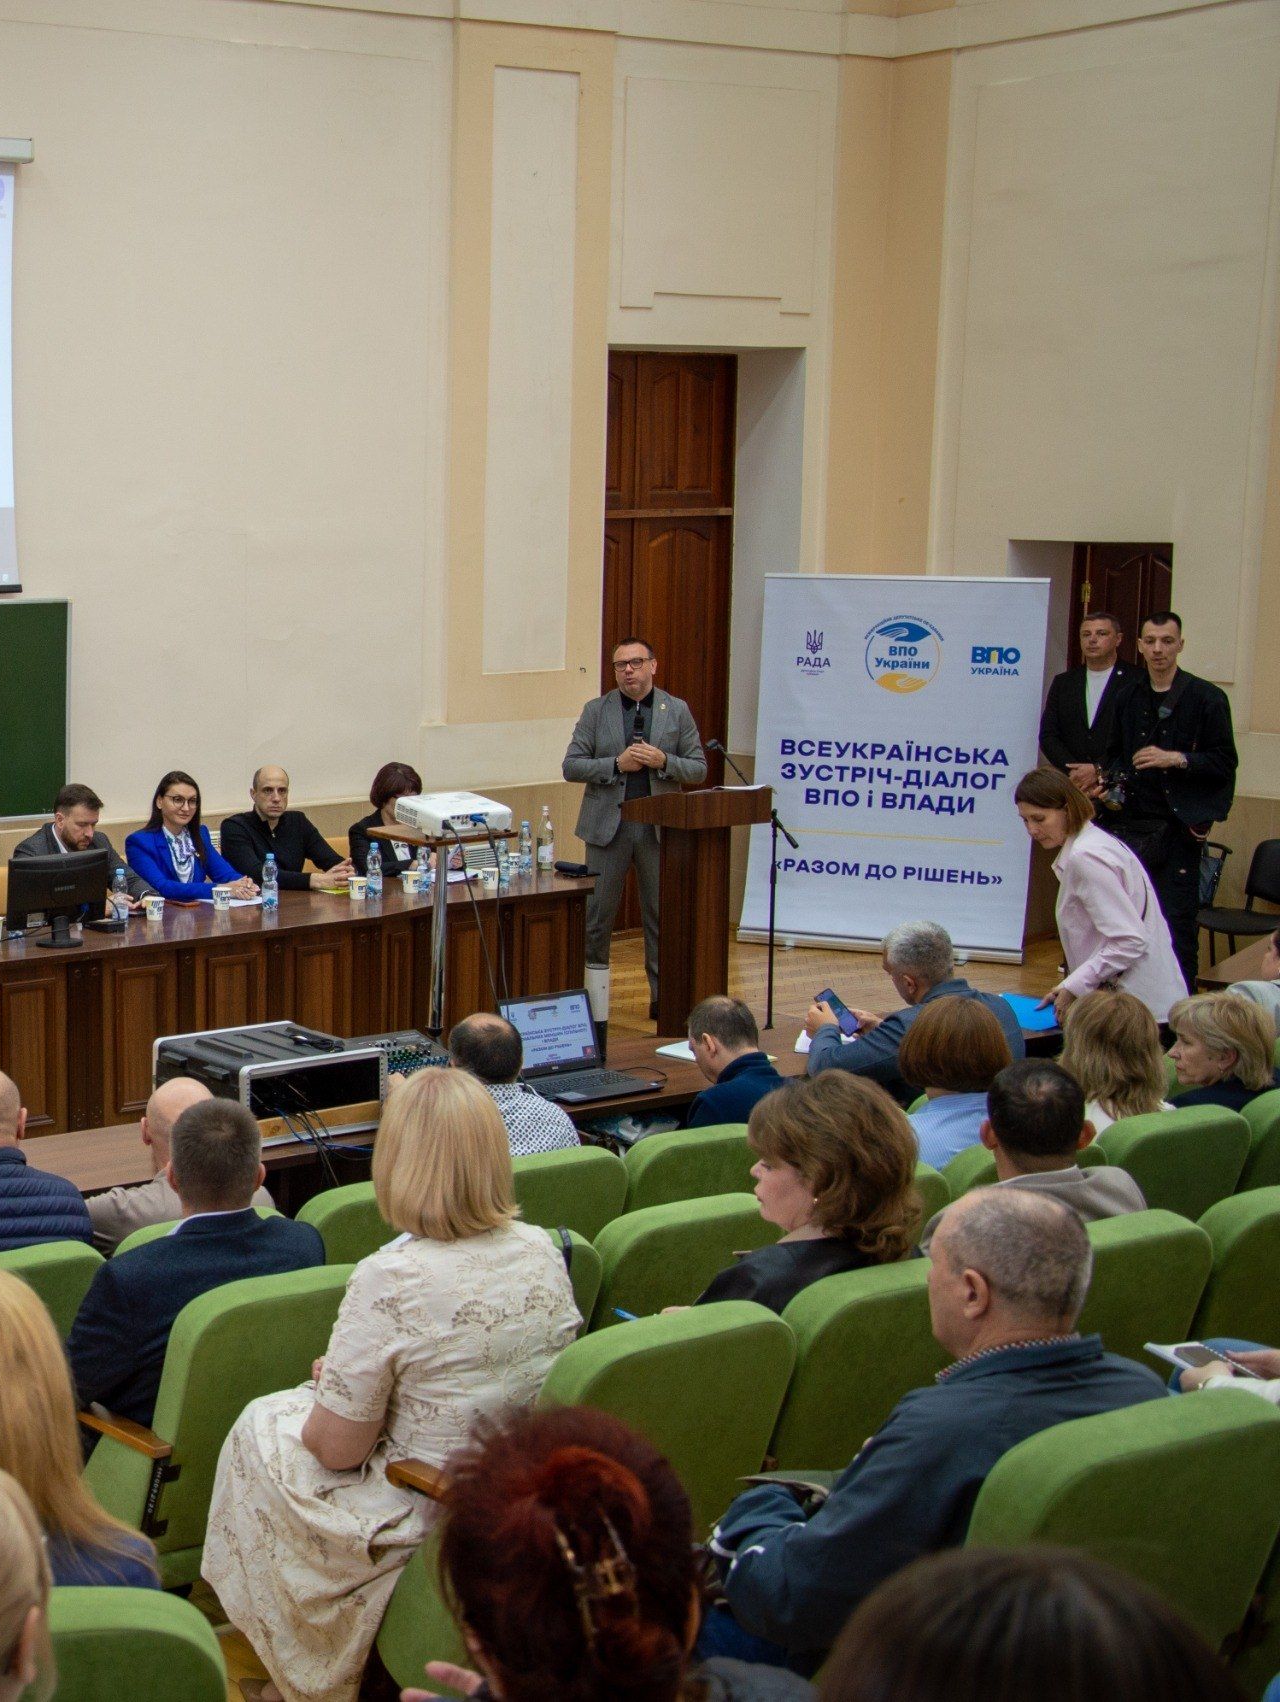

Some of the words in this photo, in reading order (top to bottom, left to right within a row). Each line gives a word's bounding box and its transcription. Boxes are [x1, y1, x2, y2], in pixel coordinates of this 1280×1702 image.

[888, 645, 918, 656] ВПО
[971, 646, 1021, 664] ВПО
[796, 656, 831, 668] РАДА
[874, 657, 930, 670] України
[971, 666, 1019, 676] УКРАЇНА
[780, 739, 1009, 767] ВСЕУКРАЇНСЬКА
[781, 763, 1006, 791] ЗУСТРІЧ-ДІАЛОГ
[804, 788, 859, 808] ВПО
[867, 789, 873, 807] і
[881, 791, 975, 816] ВЛАДИ
[865, 863, 897, 880] ДО
[903, 864, 1003, 886] РІШЕНЬ»
